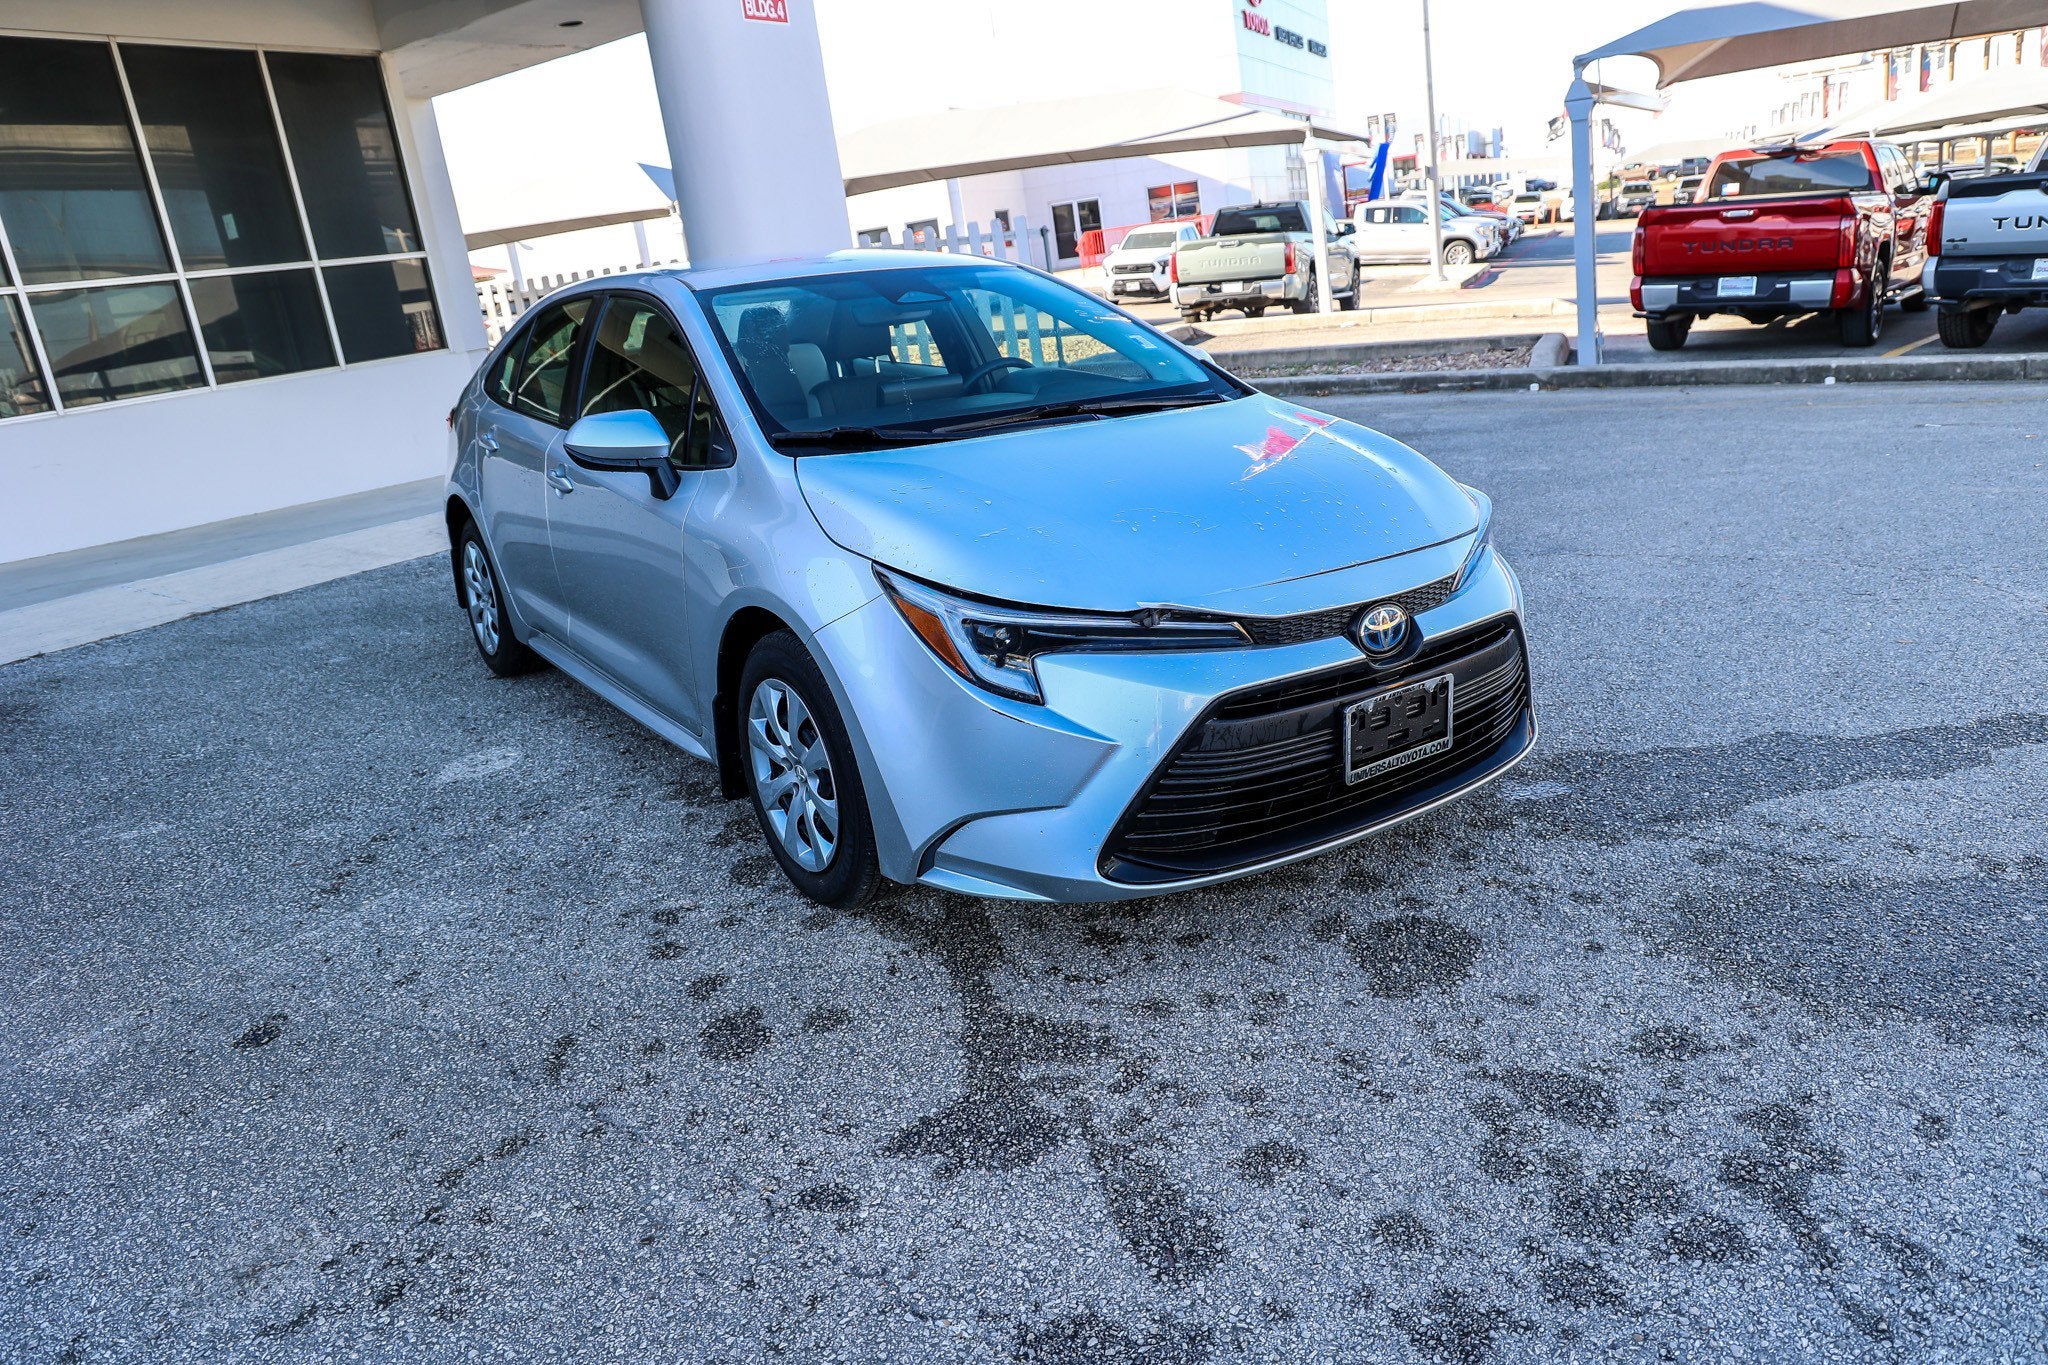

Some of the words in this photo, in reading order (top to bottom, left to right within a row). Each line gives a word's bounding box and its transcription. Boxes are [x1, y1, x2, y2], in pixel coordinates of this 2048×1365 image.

[1682, 236, 1794, 255] TUNDRA
[1200, 256, 1263, 269] TUNDRA
[1350, 739, 1449, 783] UNIVERSALTOYOTA.COM
